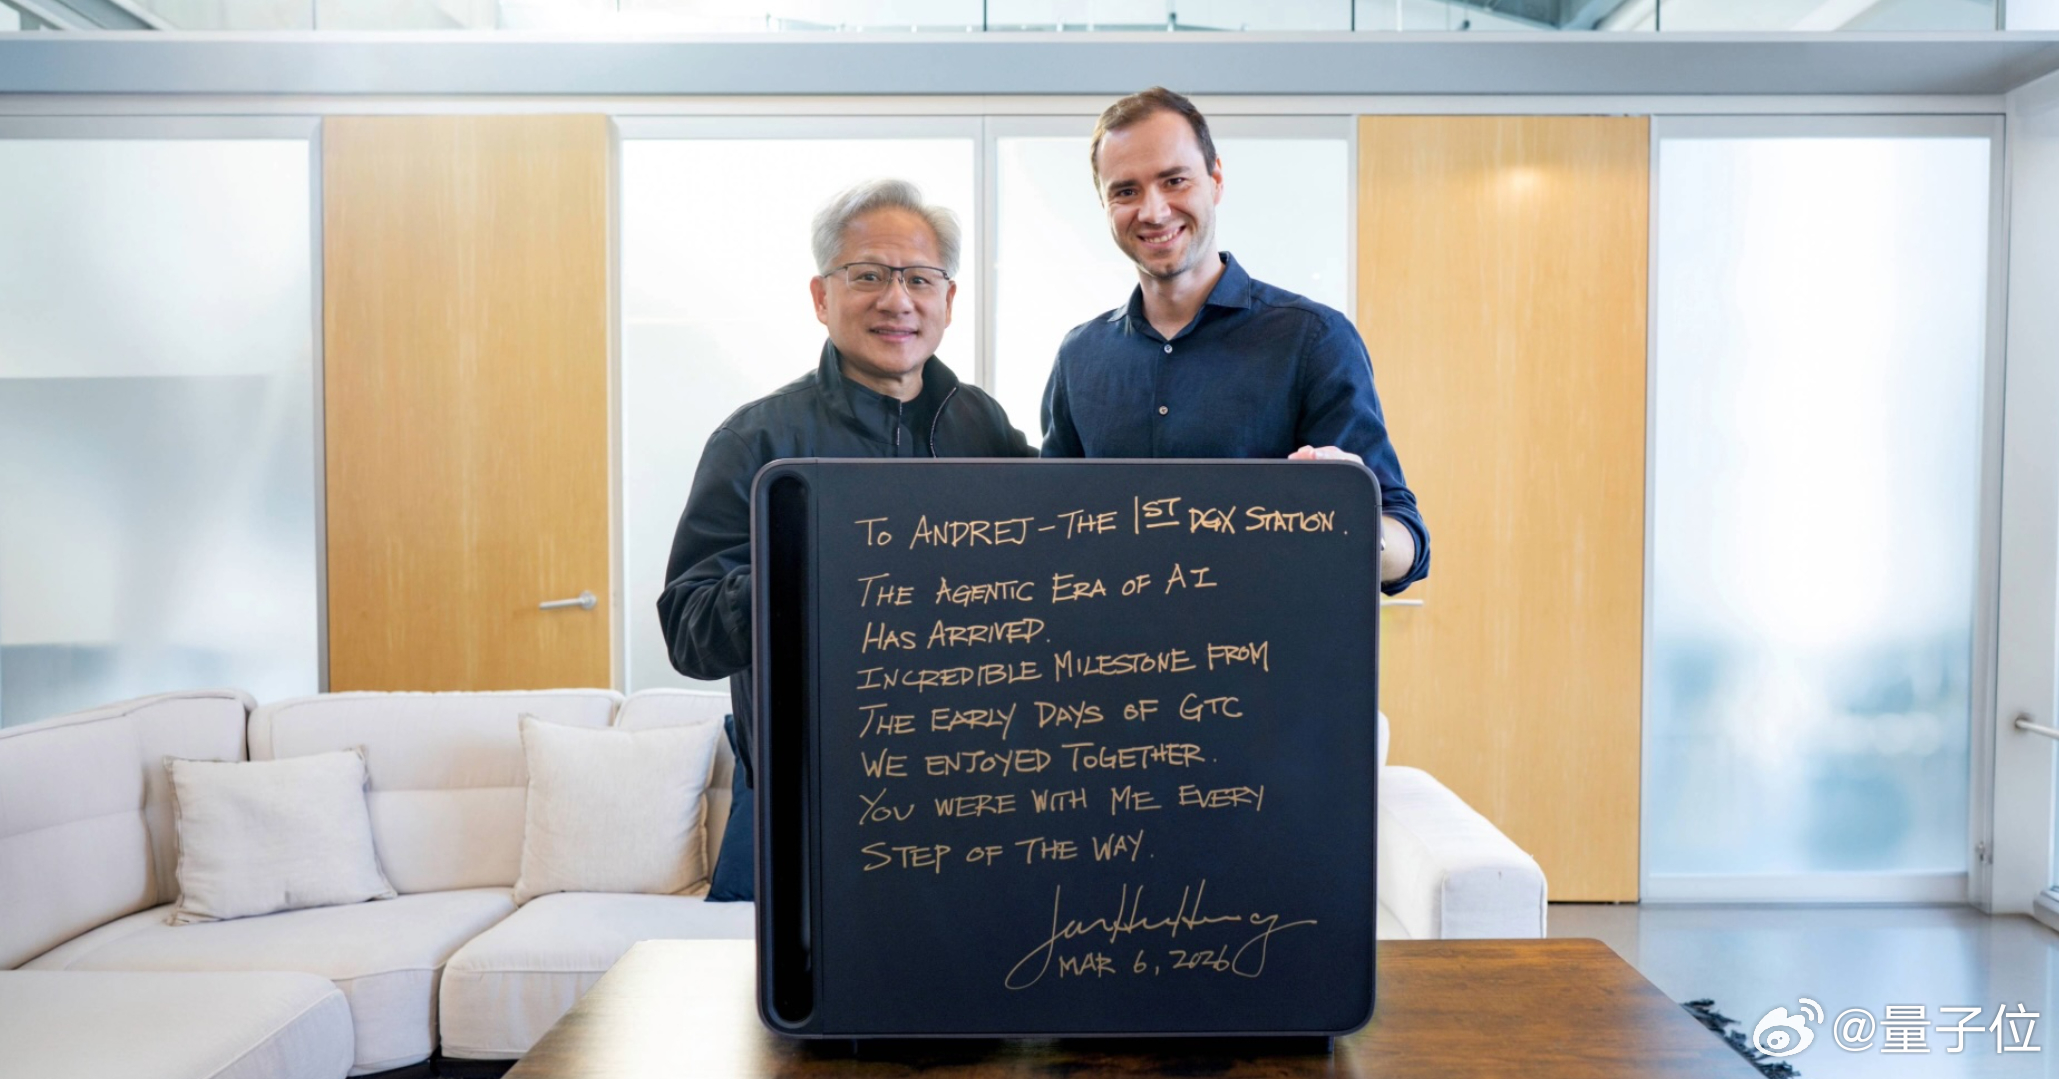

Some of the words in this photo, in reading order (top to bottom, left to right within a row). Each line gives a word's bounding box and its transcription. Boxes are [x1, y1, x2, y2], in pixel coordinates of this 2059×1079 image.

[1187, 505, 1237, 535] DGX
[857, 572, 915, 608] THE
[934, 575, 1035, 608] AGENTIC
[1051, 572, 1107, 605] ERA
[1121, 573, 1152, 597] OF
[861, 621, 917, 655] HAS
[855, 660, 1043, 694] INCREDIBLE
[1053, 647, 1197, 683] MILESTONE
[1206, 640, 1270, 673] FROM
[858, 702, 917, 739] THE
[930, 702, 1017, 741] EARLY
[1033, 700, 1105, 730] DAYS
[1122, 698, 1160, 722] OF
[1178, 692, 1244, 723] GTC
[860, 747, 909, 779] WE
[924, 747, 1052, 778] ENJOYED
[933, 793, 1017, 818] WERE
[1030, 787, 1088, 814] WITH
[1110, 784, 1163, 817] ME
[1178, 783, 1265, 812] EVERY
[860, 841, 952, 875] STEP
[965, 845, 1004, 867] OF
[1014, 836, 1078, 865] THE
[1058, 951, 1117, 979] MAR
[1168, 944, 1231, 972] 2026
